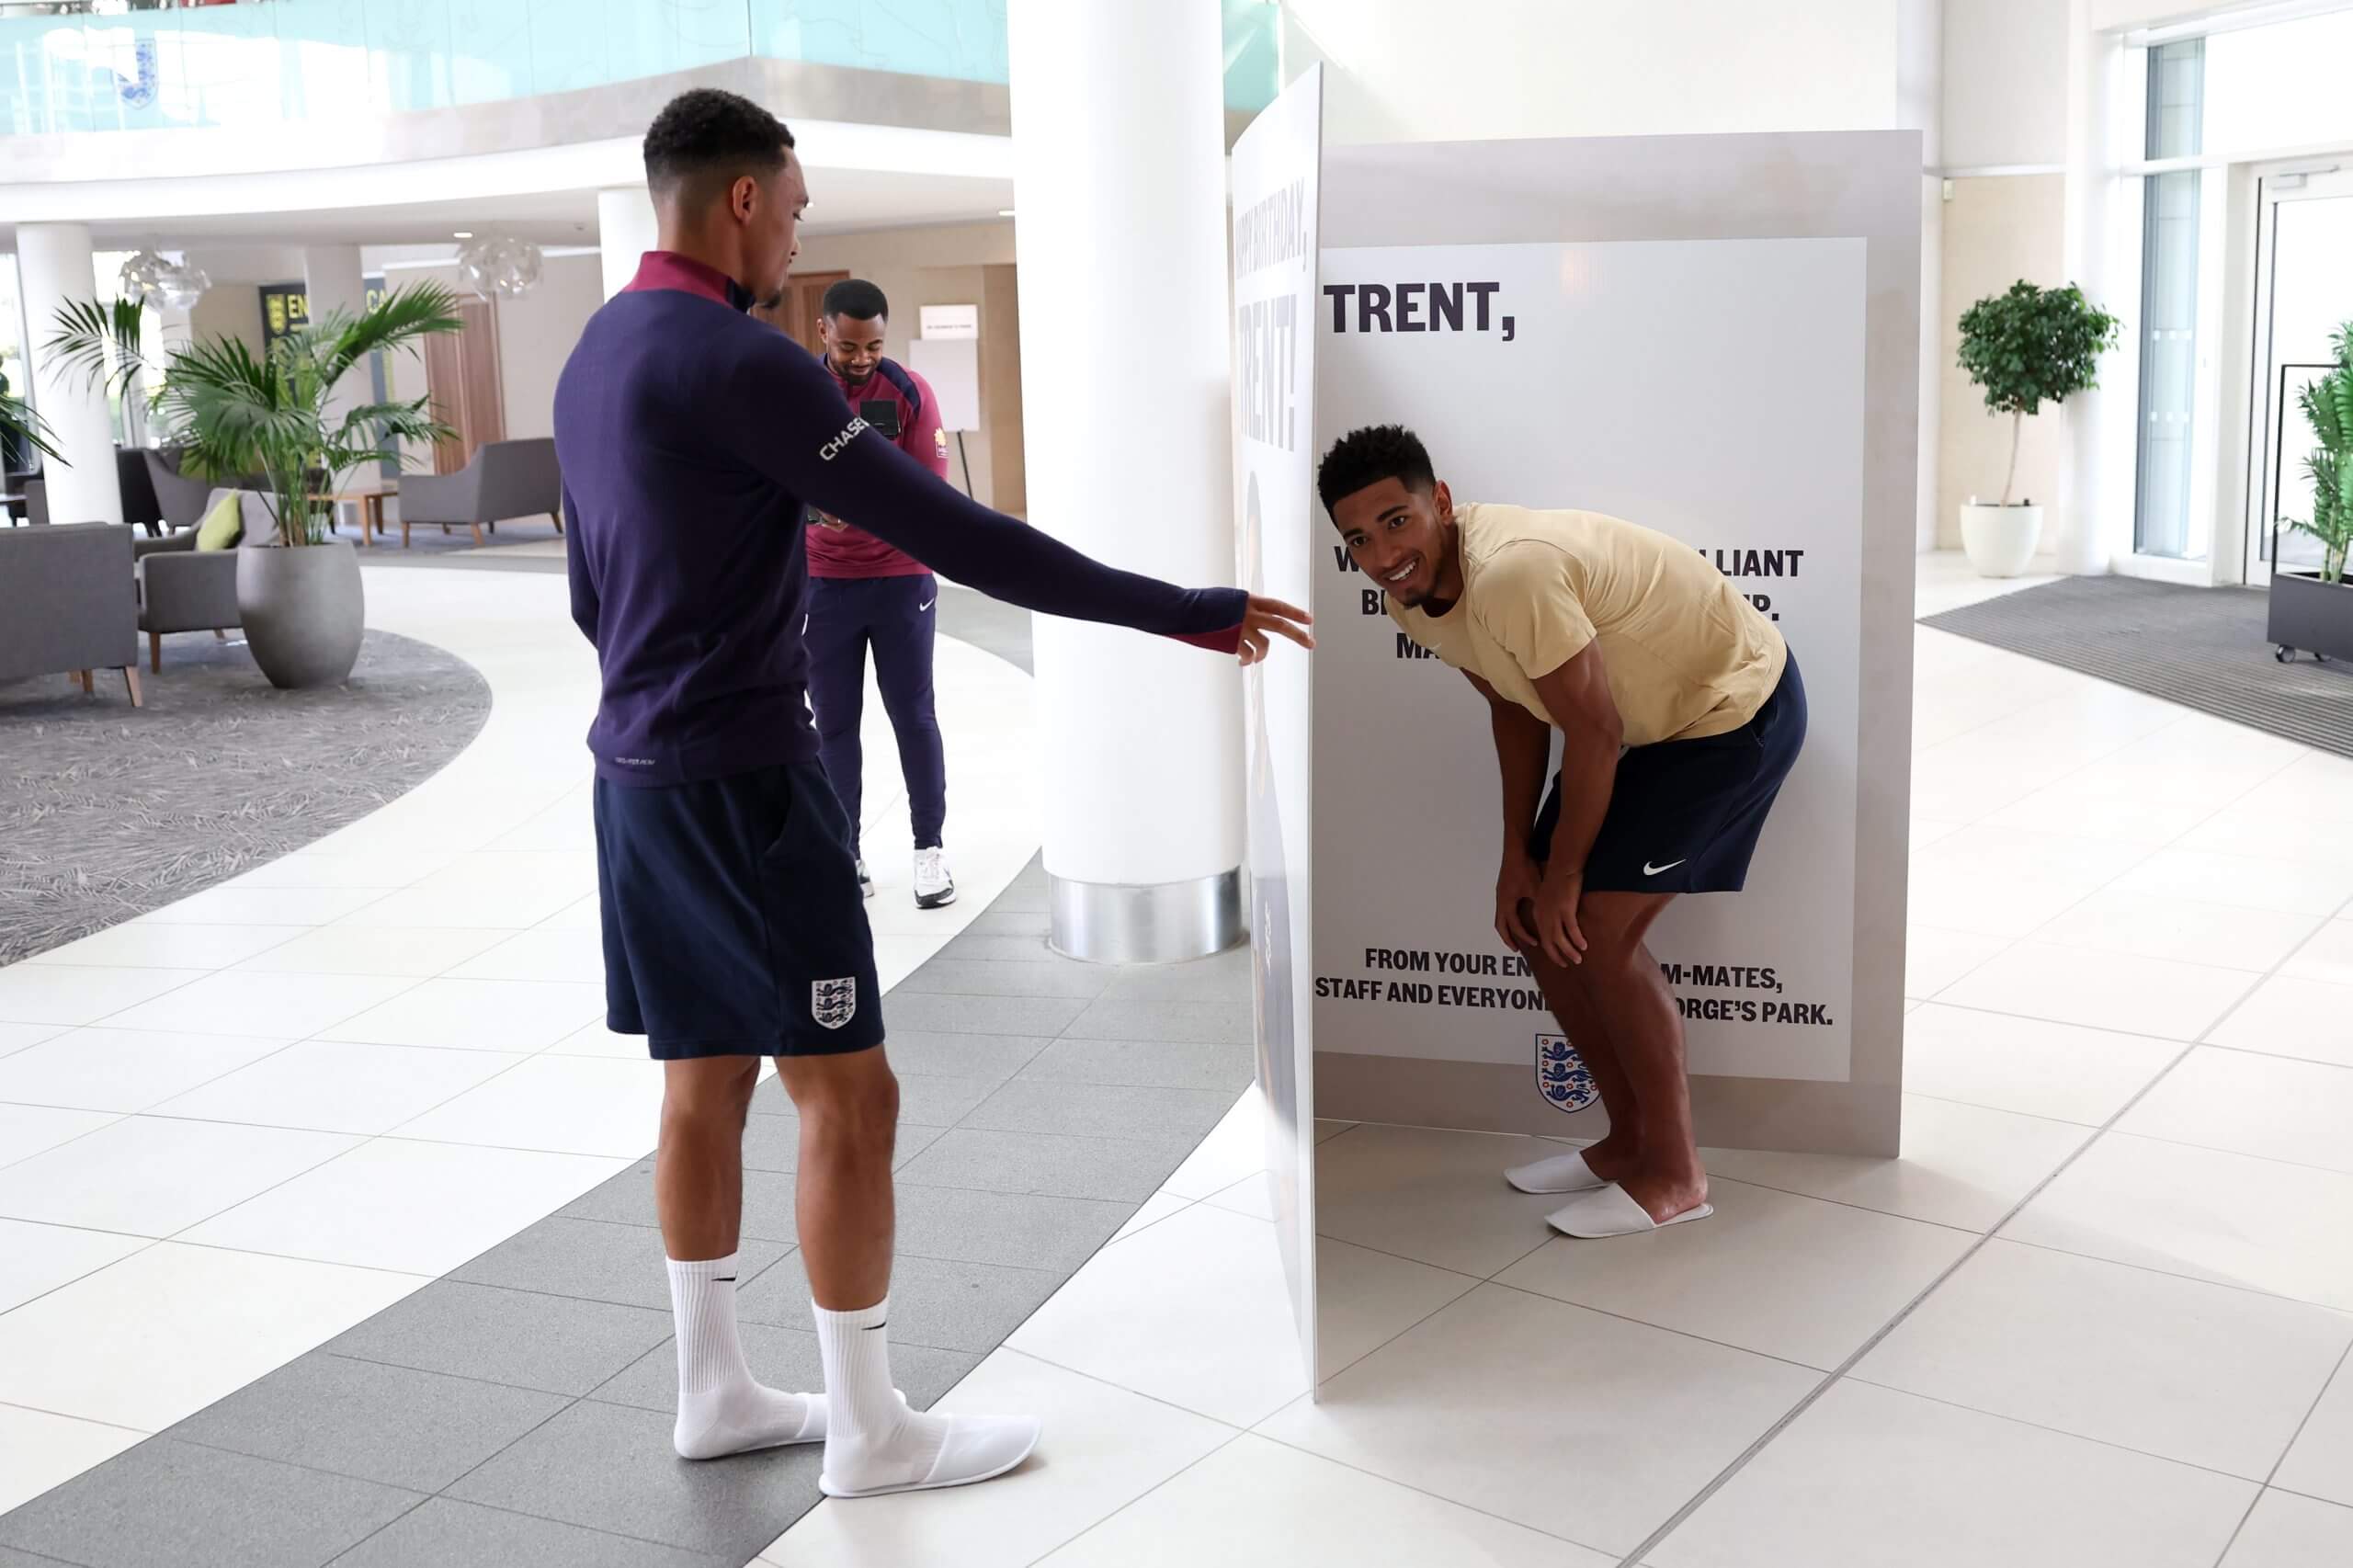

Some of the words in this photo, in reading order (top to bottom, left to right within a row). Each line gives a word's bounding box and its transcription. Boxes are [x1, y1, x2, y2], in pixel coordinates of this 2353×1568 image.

[1253, 176, 1306, 272] BIRTHDAY,
[1324, 282, 1515, 341] TRENT,
[1237, 293, 1297, 452] TRENT!
[819, 416, 866, 460] CHASE
[1699, 549, 1803, 577] LIANT
[1365, 948, 1430, 971] FROM
[1435, 952, 1497, 976] YOUR
[1315, 977, 1382, 1001] STAFF
[1387, 982, 1433, 1004] AND
[1660, 963, 1783, 994] M-MATES,
[1675, 997, 1757, 1022] RGE'S
[1762, 1002, 1834, 1026] PARK.
